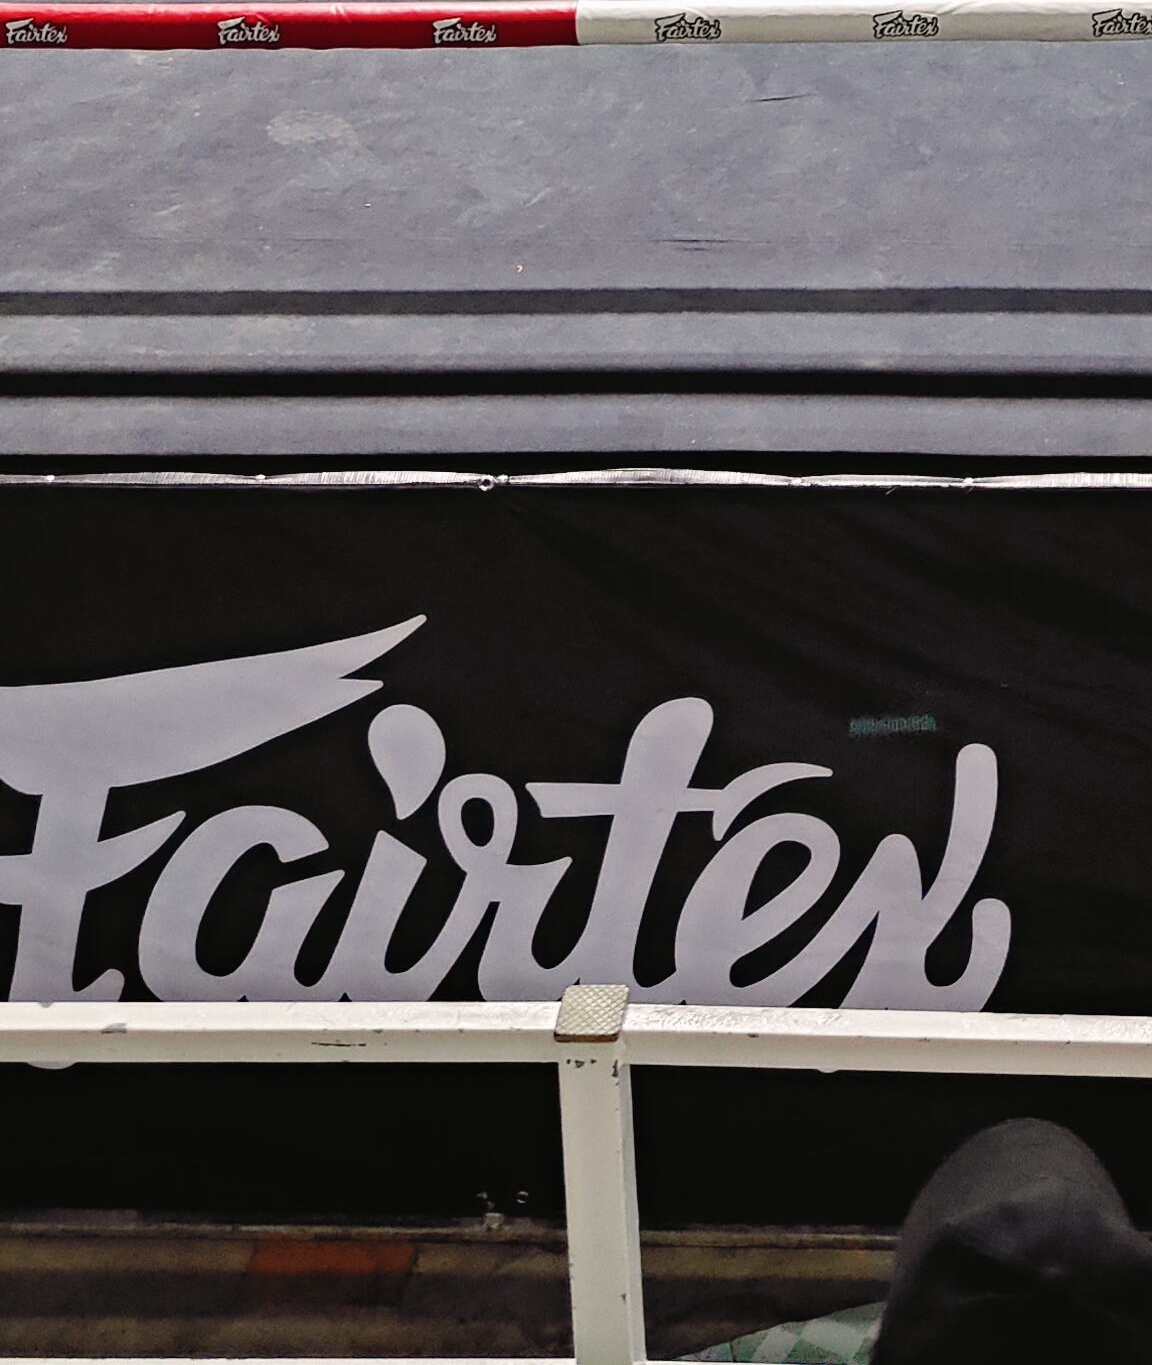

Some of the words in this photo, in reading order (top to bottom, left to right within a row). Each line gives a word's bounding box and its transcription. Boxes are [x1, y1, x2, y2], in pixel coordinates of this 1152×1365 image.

[5, 18, 68, 45] Fairtex
[217, 17, 280, 45] Fairtex
[432, 17, 497, 45] Fairtex
[654, 12, 722, 42] Fairtex
[872, 9, 939, 39] Fairtex
[0, 614, 1012, 1014] Fairtex
